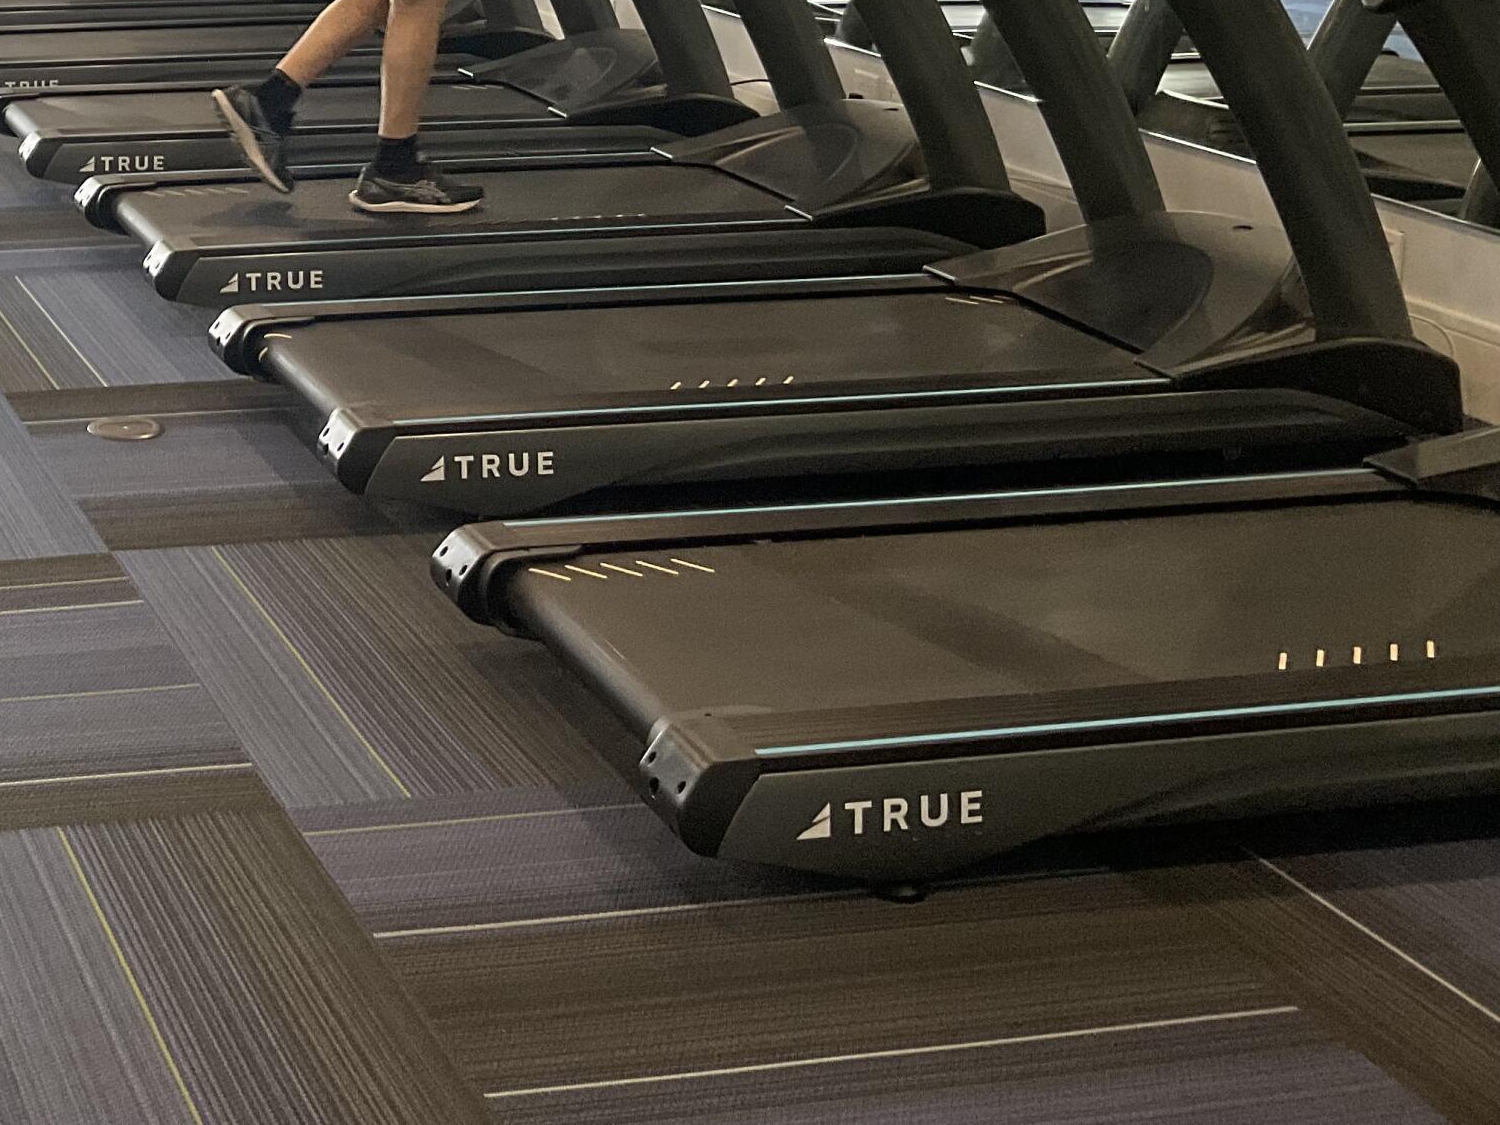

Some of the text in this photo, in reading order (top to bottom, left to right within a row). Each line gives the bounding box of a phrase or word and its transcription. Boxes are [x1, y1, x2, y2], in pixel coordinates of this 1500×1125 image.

[101, 155, 164, 171] TRUE
[245, 270, 324, 291] TRUE
[454, 451, 555, 480] TRUE
[844, 790, 983, 835] TRUE
